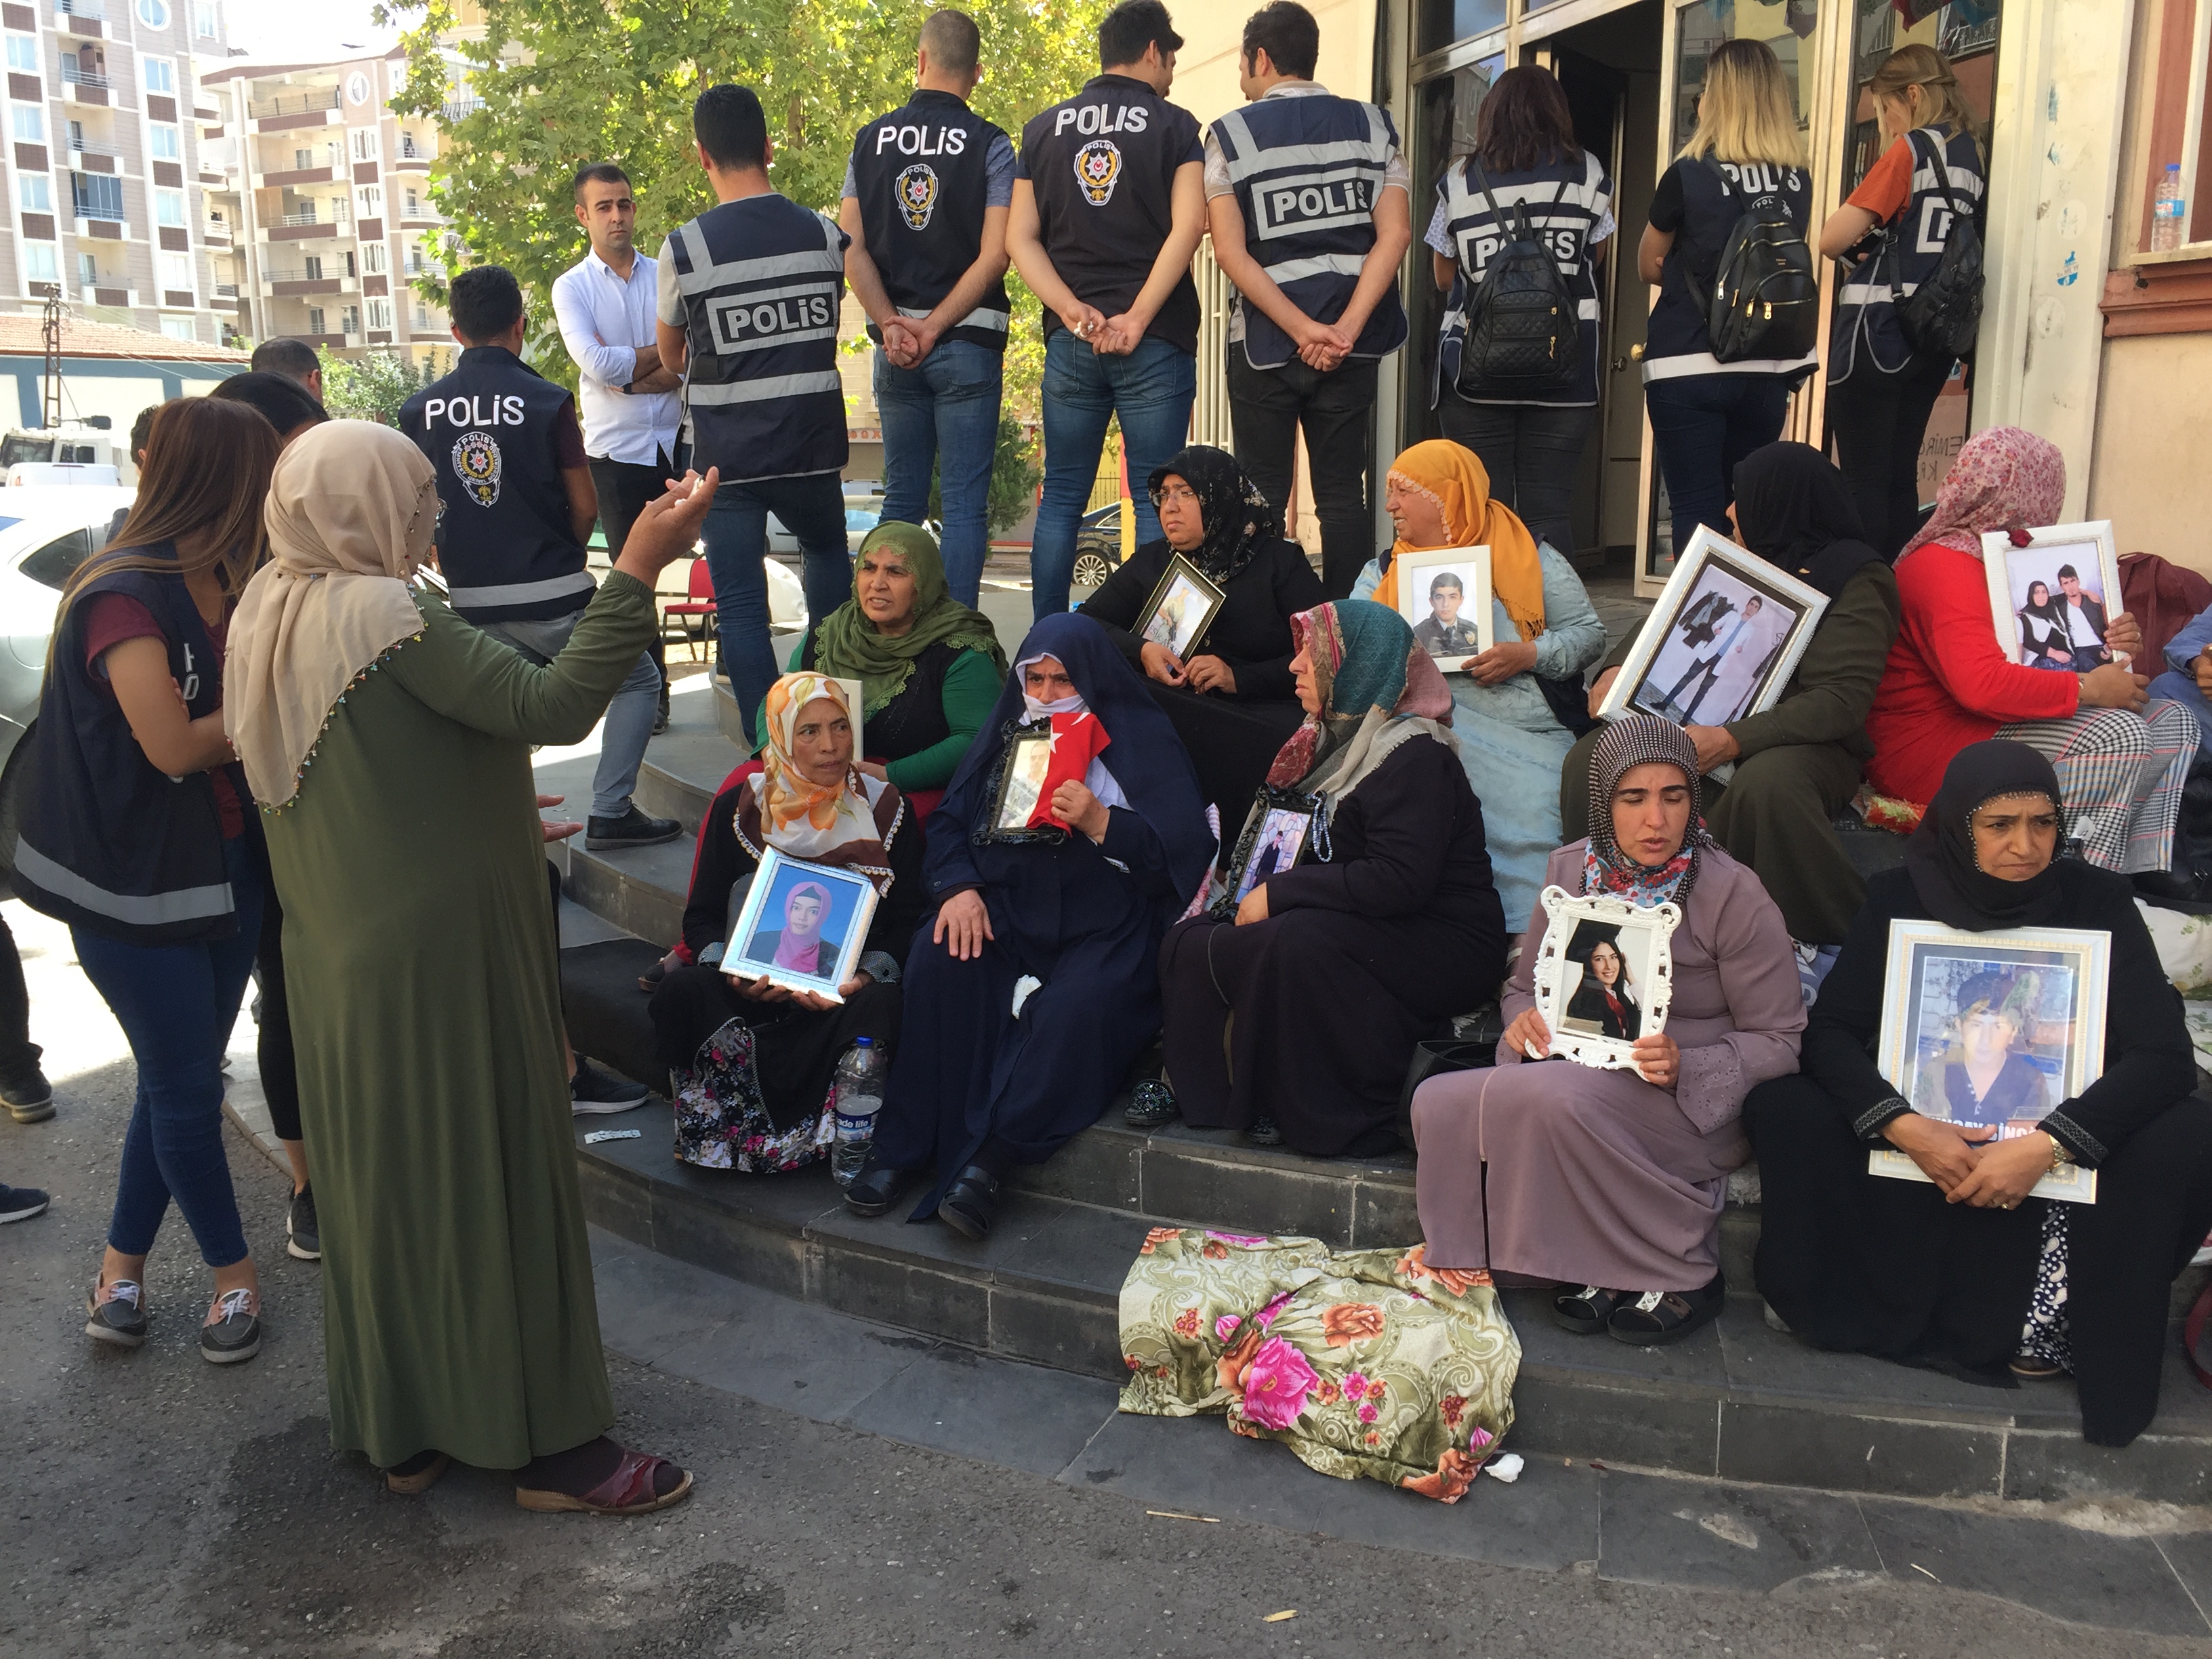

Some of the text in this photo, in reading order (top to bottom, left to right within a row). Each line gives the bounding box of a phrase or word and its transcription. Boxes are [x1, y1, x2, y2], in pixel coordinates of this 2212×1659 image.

[876, 125, 968, 155] POLİS
[1720, 162, 1801, 197] POLS
[1475, 231, 1576, 268] PİS
[725, 297, 830, 339] POLİS
[425, 394, 525, 430] POLİS
